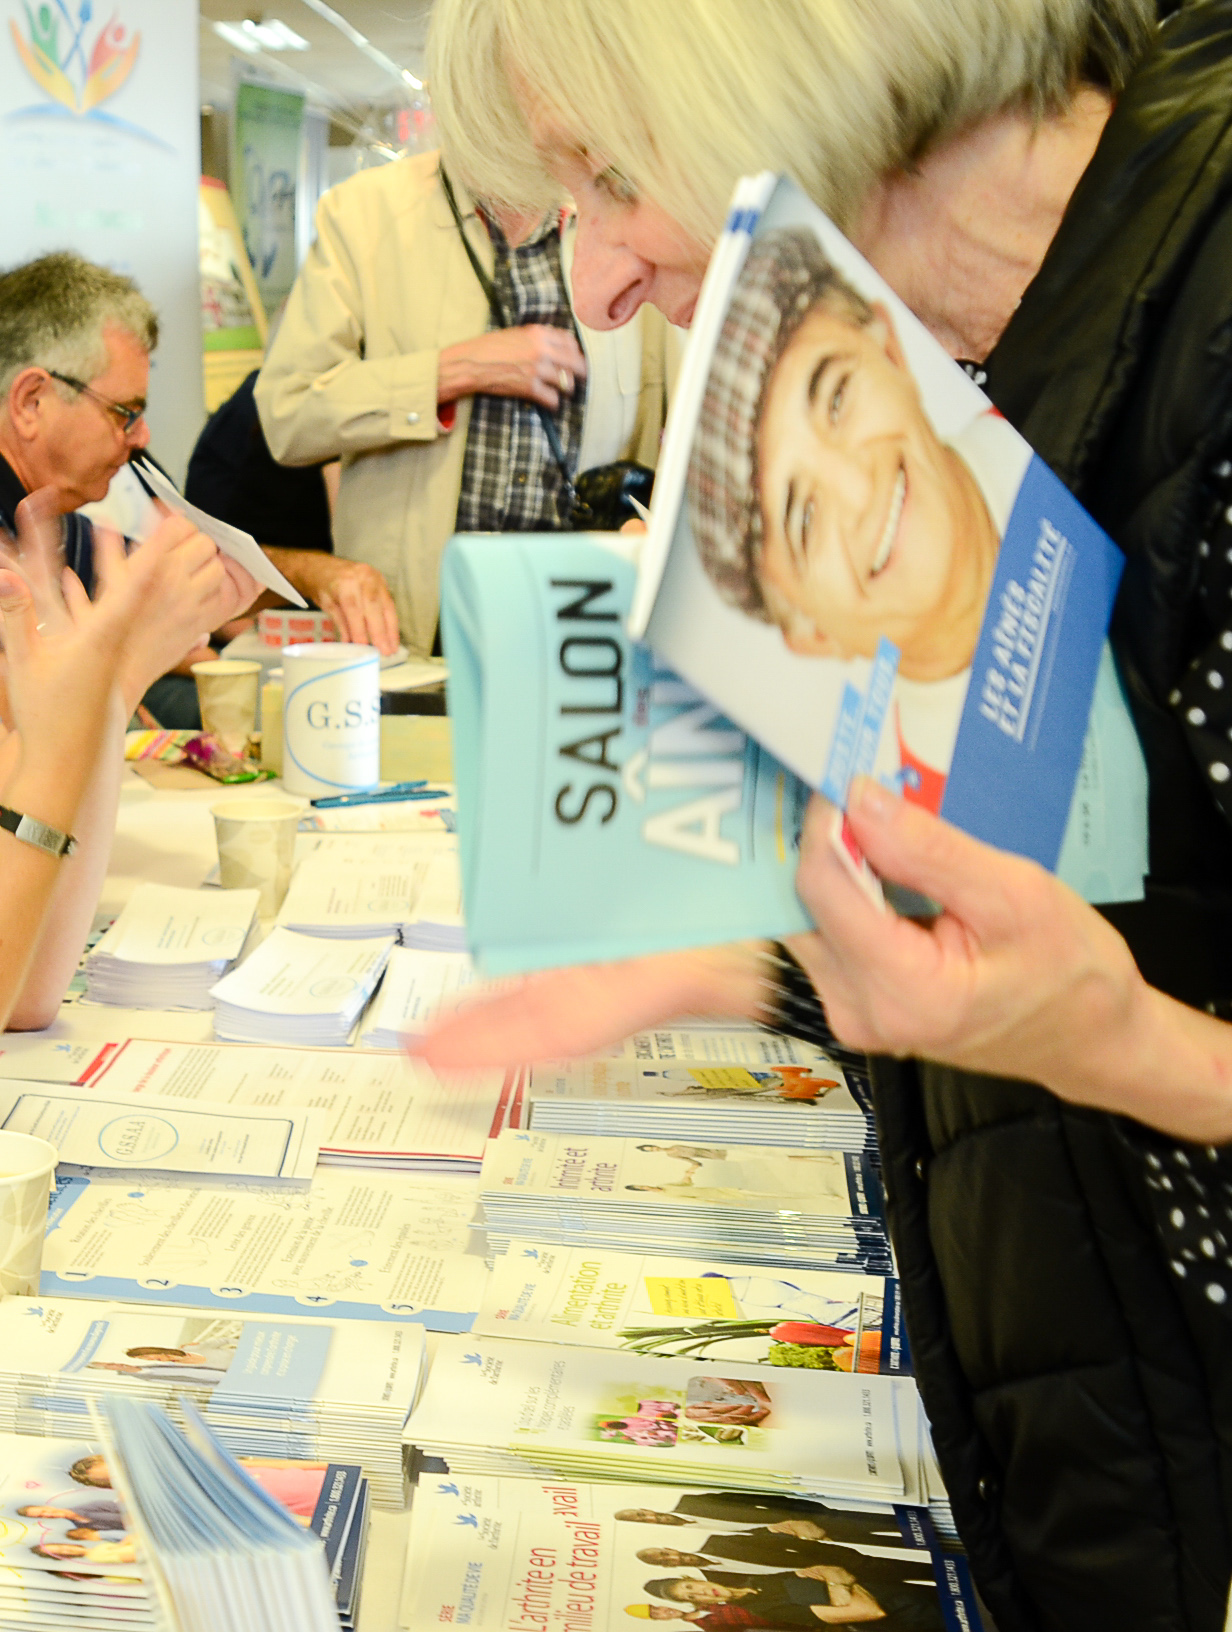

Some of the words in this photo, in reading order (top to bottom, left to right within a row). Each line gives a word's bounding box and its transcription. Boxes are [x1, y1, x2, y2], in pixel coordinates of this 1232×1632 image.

[550, 578, 623, 831] SALON
[564, 1147, 588, 1158] et
[550, 1159, 586, 1190] Intimité
[584, 1162, 617, 1193] arthrite
[146, 1278, 169, 1286] 2
[220, 1286, 242, 1294] 3
[551, 1261, 602, 1327] Alimentation
[391, 1303, 413, 1311] 5
[591, 1281, 628, 1319] arthrite
[529, 1547, 557, 1568] en
[564, 1520, 601, 1569] travail
[557, 1570, 597, 1591] de
[508, 1570, 555, 1632] L'arthrite
